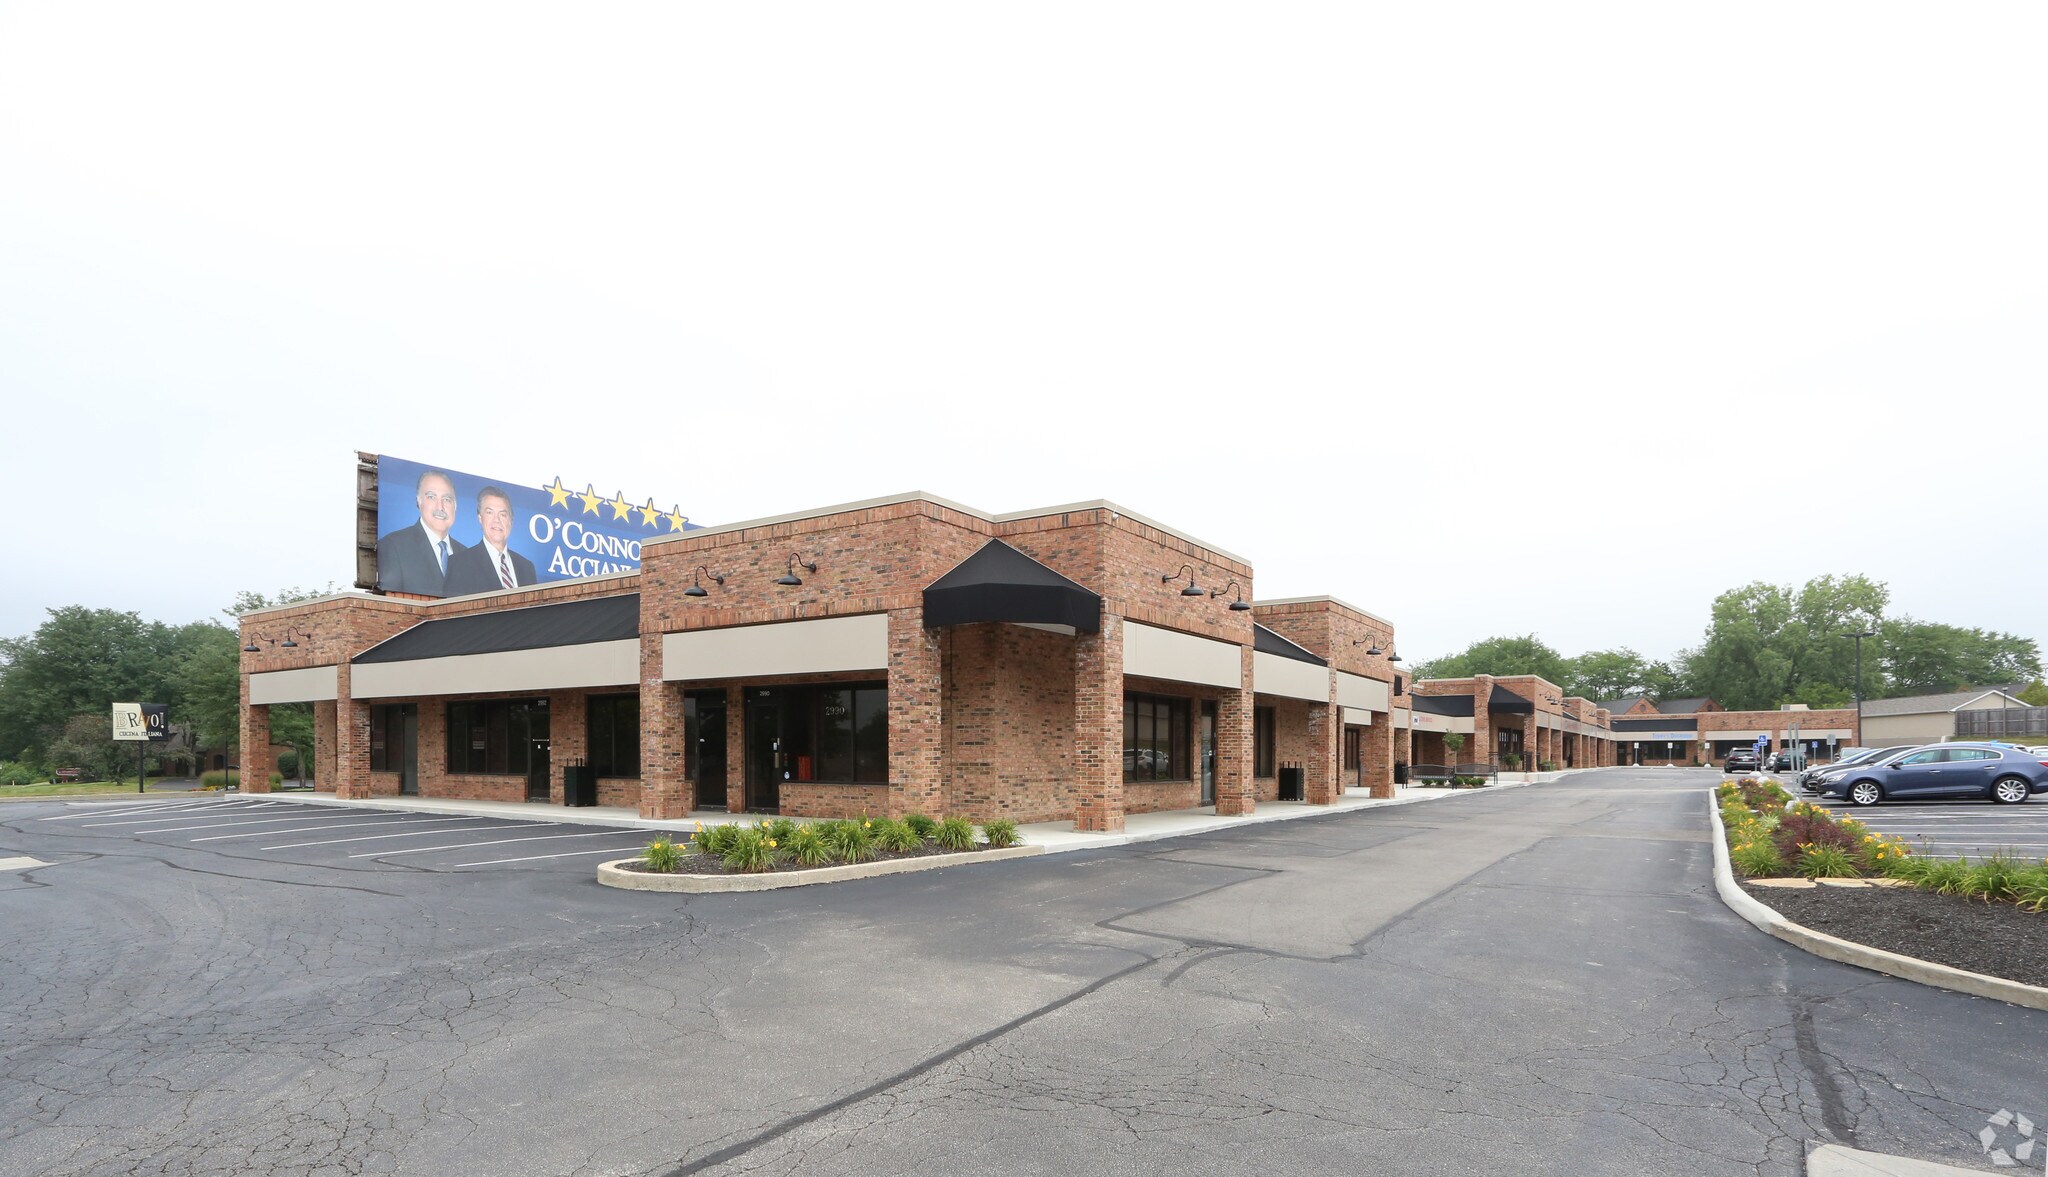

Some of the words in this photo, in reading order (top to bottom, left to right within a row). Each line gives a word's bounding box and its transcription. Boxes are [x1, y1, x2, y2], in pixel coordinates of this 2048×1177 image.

[548, 546, 632, 578] ACCIAN
[115, 711, 165, 729] BRAVO!
[825, 706, 845, 716] 2990
